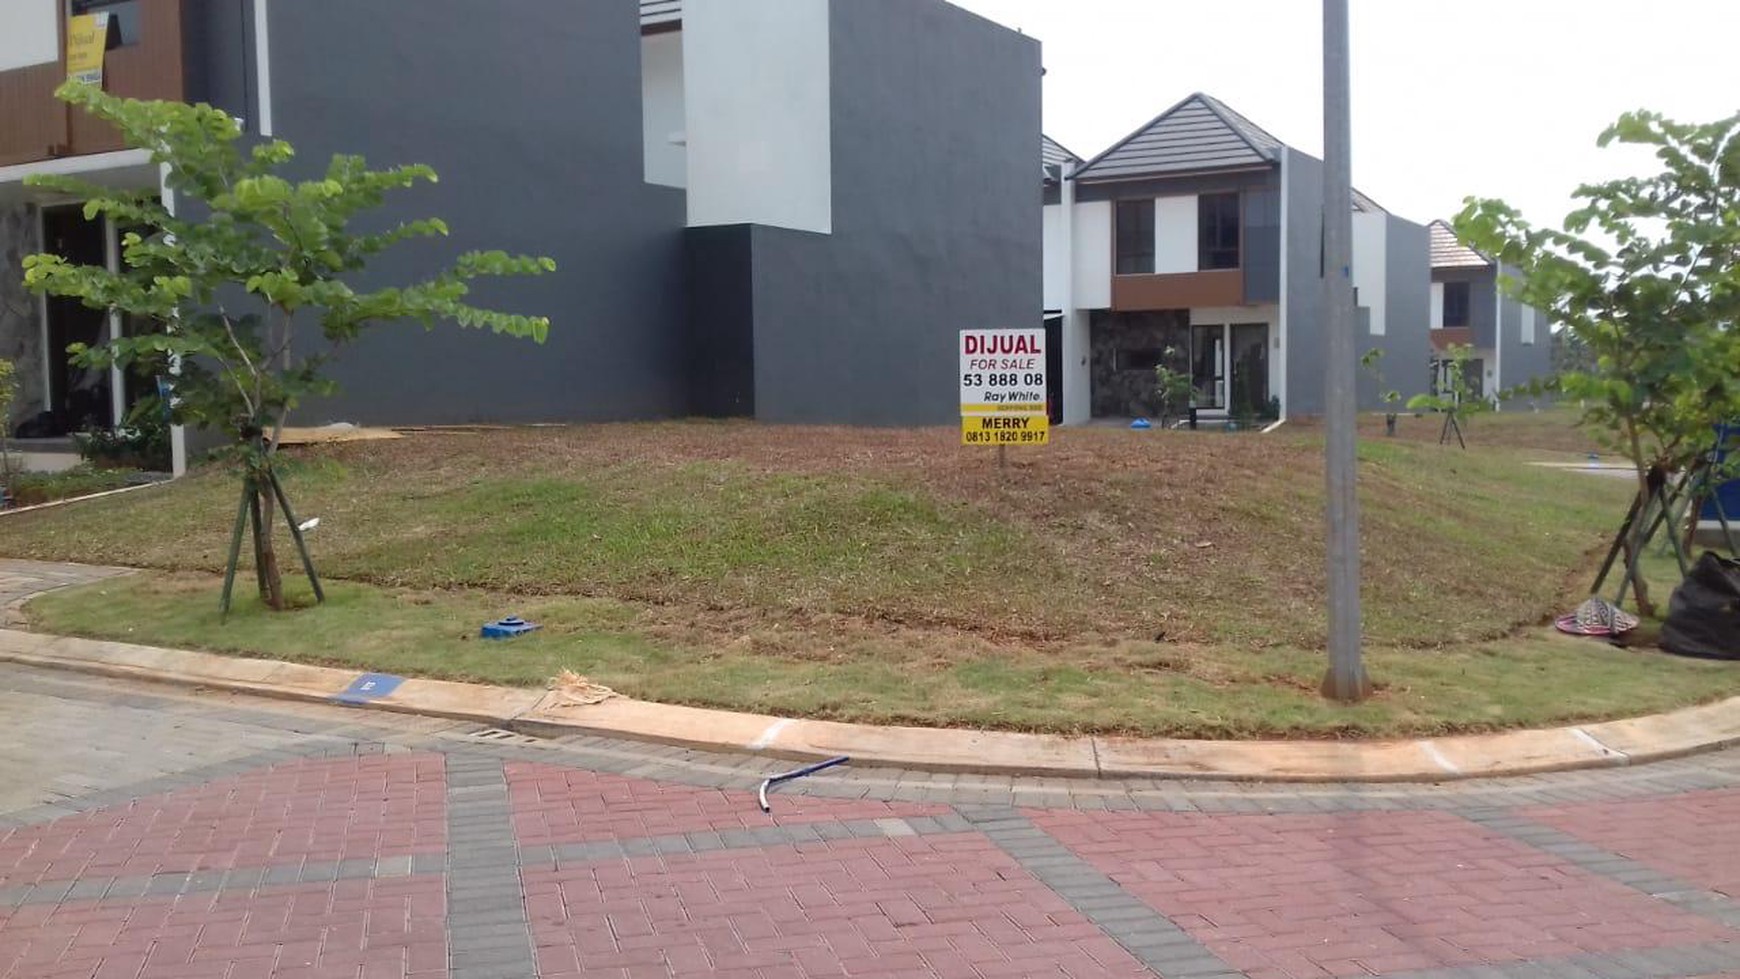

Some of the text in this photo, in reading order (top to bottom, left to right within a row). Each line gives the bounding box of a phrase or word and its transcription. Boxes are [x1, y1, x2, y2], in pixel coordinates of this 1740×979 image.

[964, 334, 1042, 355] DIJUAL
[970, 358, 1036, 370] FOR SALE
[963, 373, 1043, 387] 53 888 08
[984, 391, 1040, 402] Ray White
[982, 417, 1030, 430] MERRY
[966, 431, 1045, 442] 0813 1820 9917
